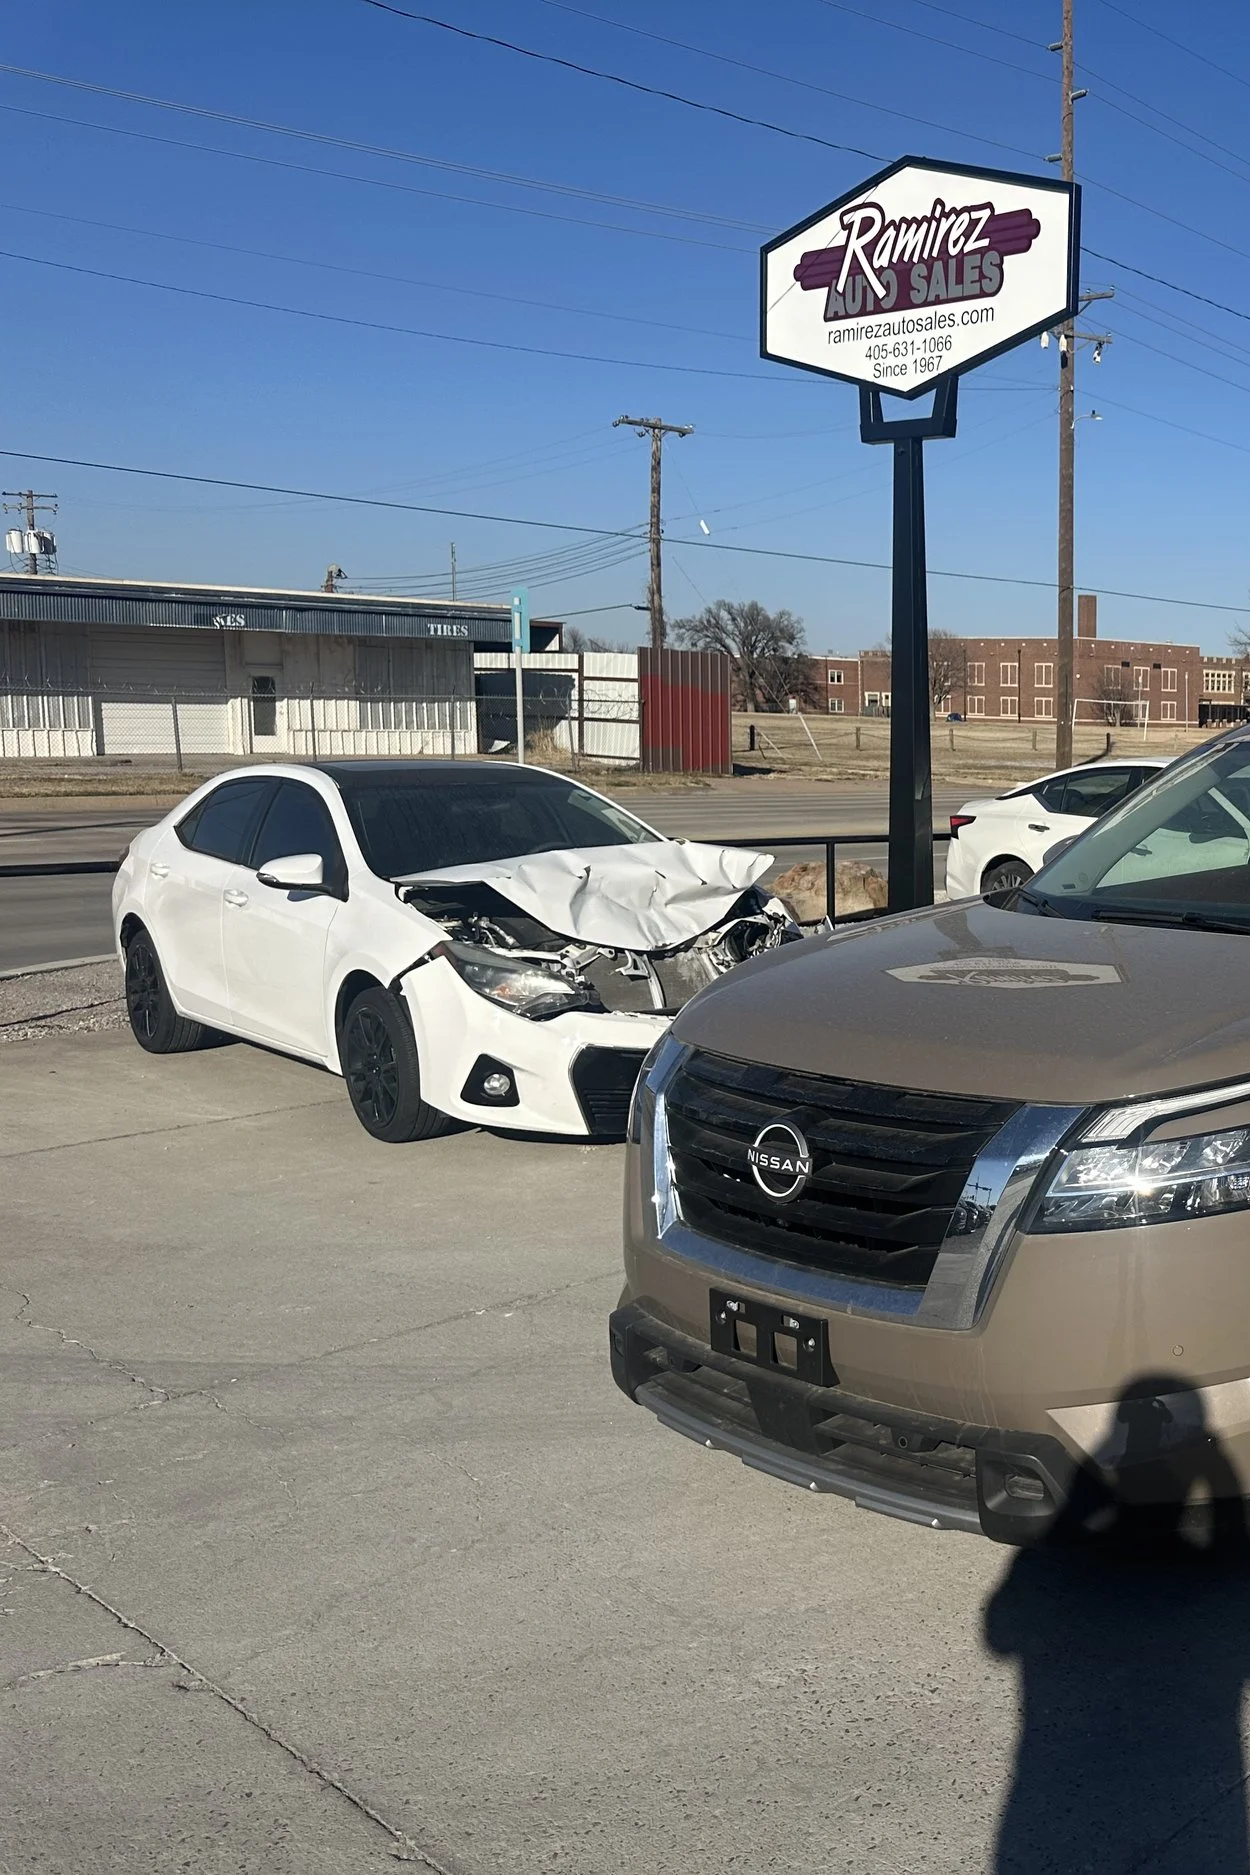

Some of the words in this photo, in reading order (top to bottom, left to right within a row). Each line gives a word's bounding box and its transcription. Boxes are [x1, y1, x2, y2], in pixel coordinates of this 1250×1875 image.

[836, 203, 992, 300] Ramirez
[826, 268, 898, 318] AUTO
[909, 250, 1001, 305] SALES
[828, 307, 995, 345] ramirezautosales.com
[865, 334, 953, 361] 405-631-1066
[873, 361, 908, 379] Since
[912, 355, 943, 374] 1967
[427, 623, 469, 637] TIRES
[747, 1148, 810, 1174] NISSAN
